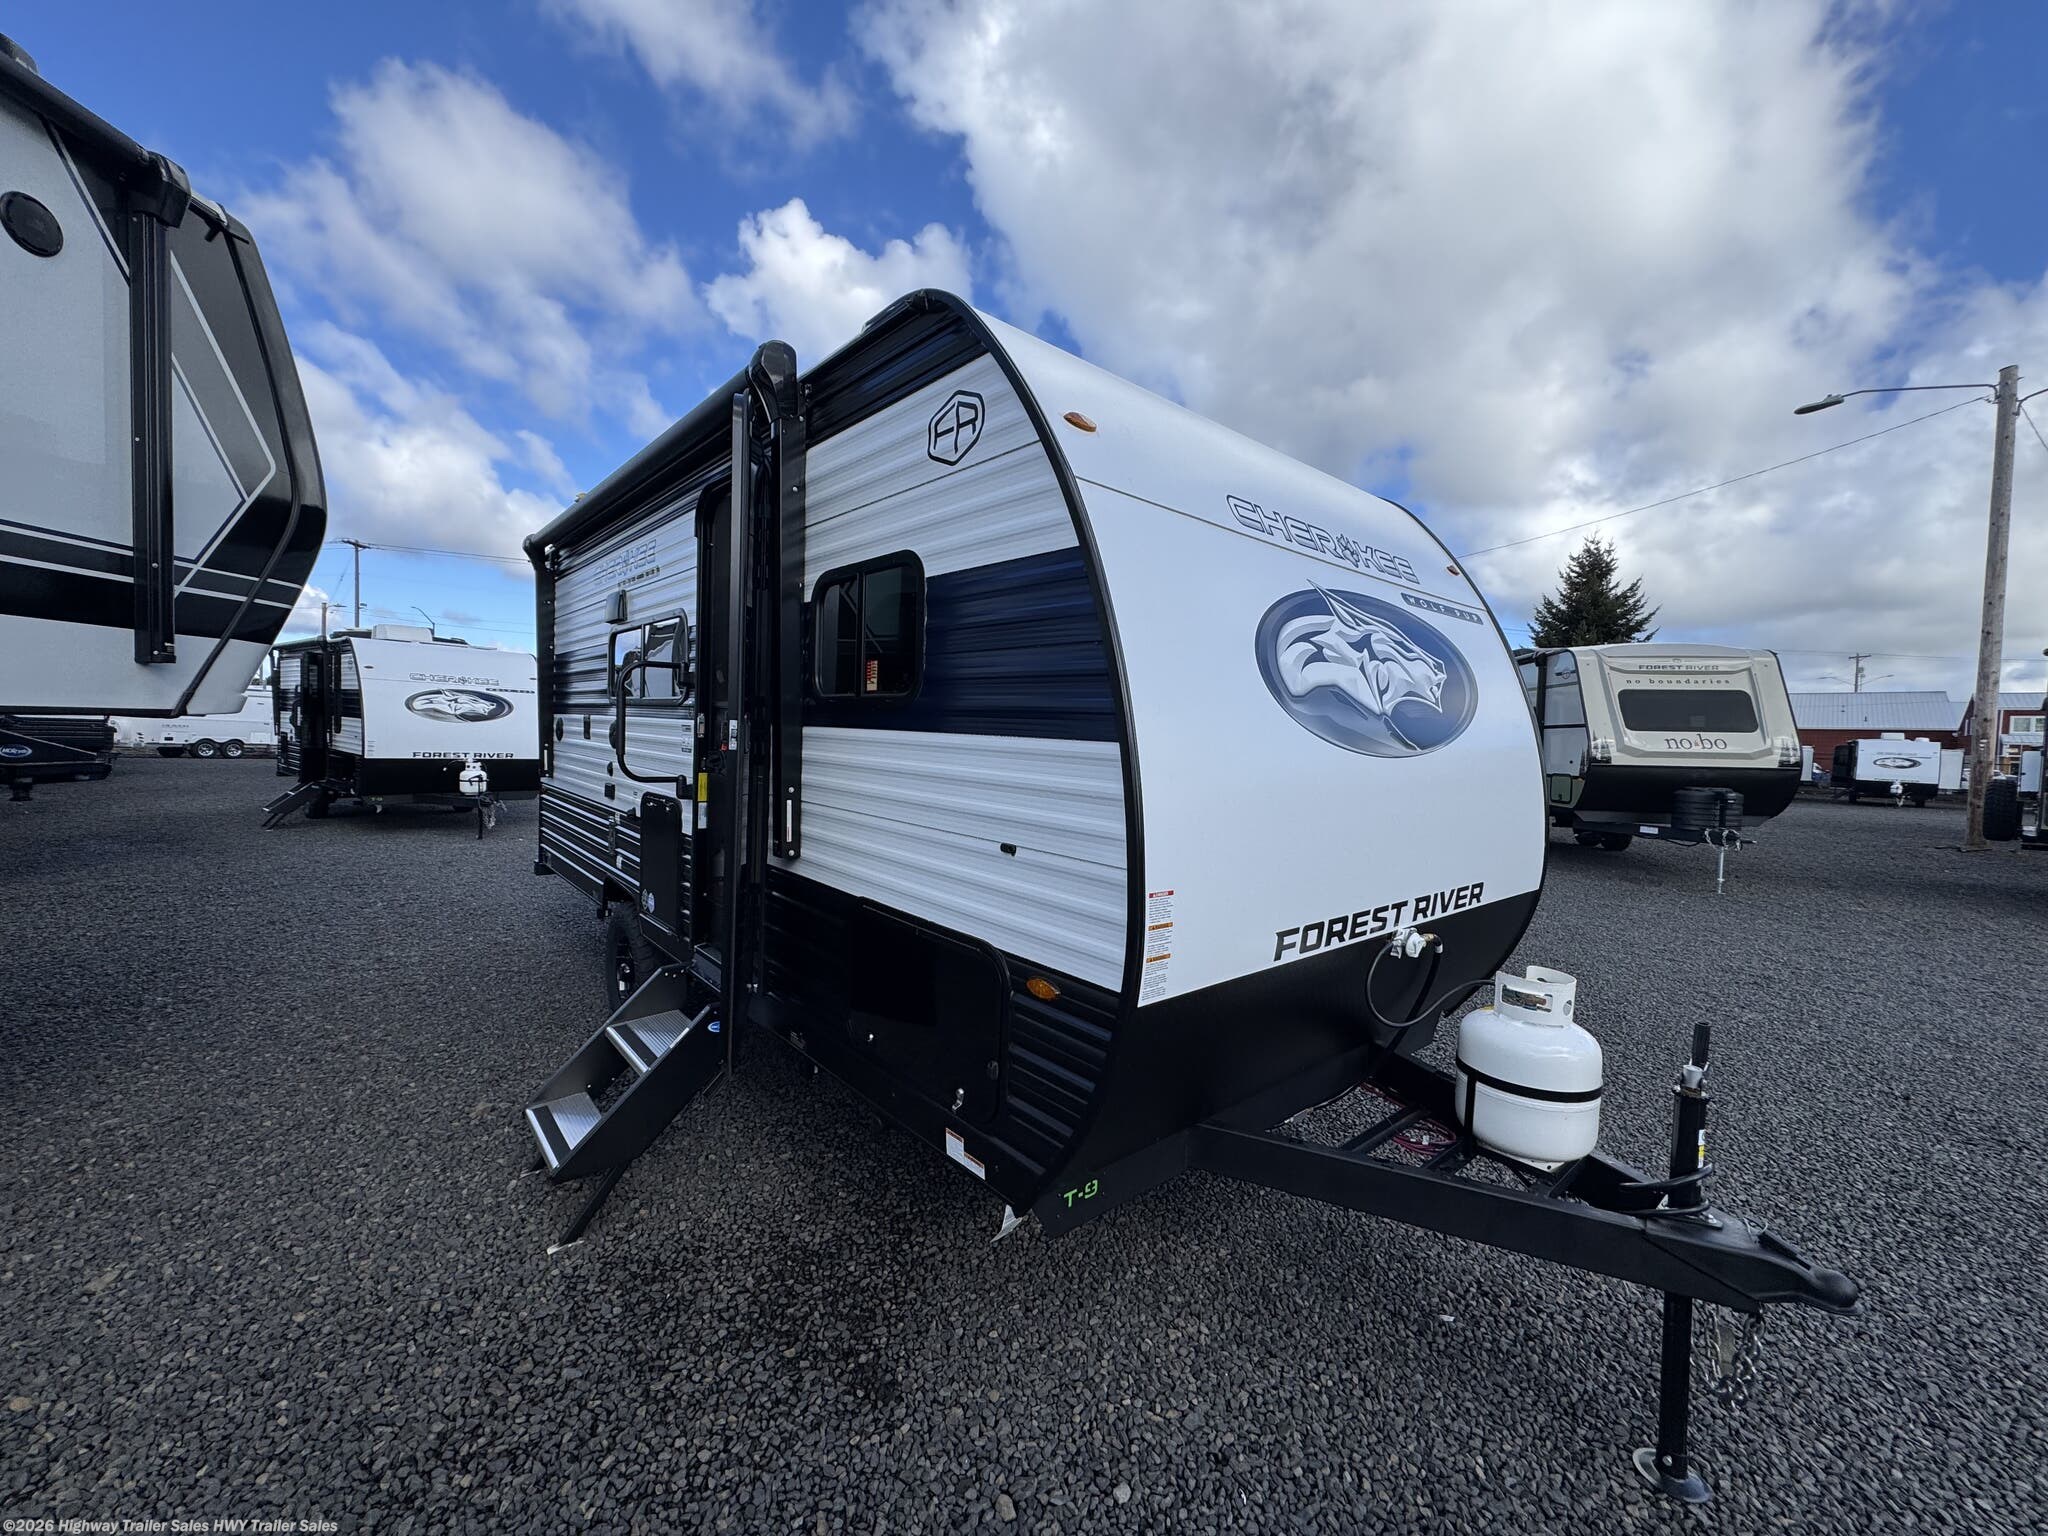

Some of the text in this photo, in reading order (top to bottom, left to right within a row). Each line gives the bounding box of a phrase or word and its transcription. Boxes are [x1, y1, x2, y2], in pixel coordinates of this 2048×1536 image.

[412, 751, 471, 759] FOREST
[1273, 882, 1485, 962] FOREST RIVER
